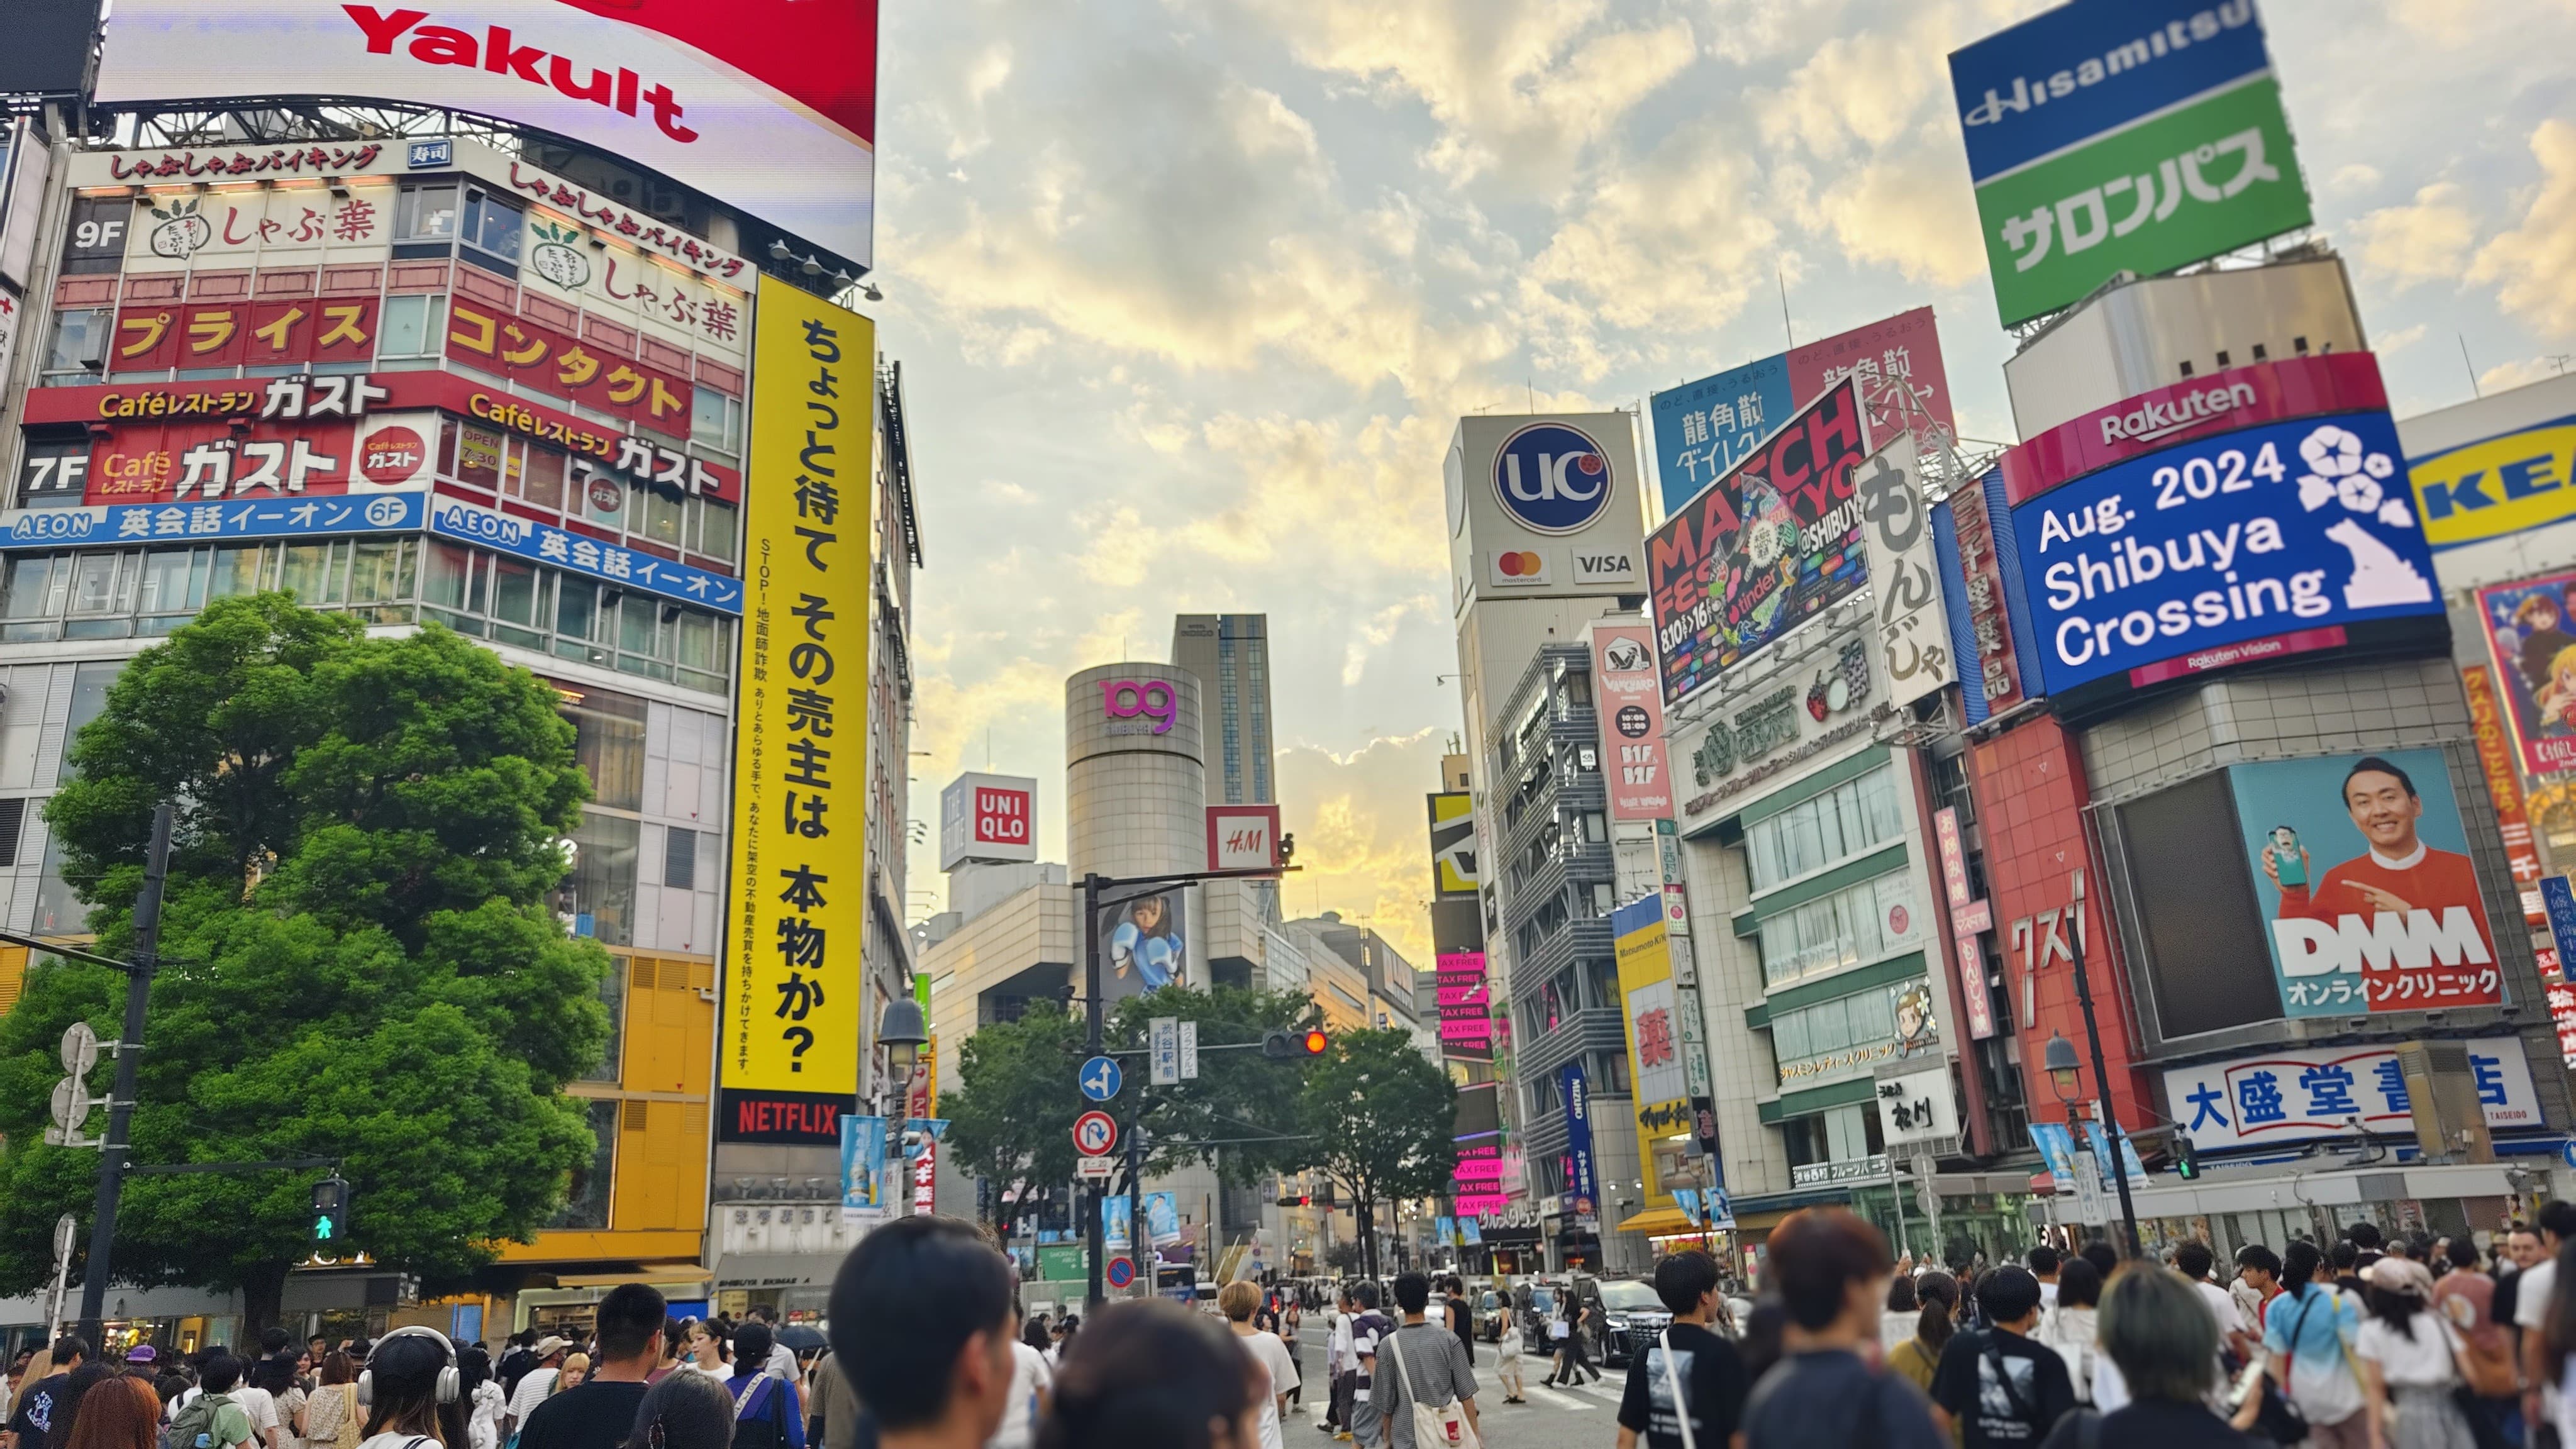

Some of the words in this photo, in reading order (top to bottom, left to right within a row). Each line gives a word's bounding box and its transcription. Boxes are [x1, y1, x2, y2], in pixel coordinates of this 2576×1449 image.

[341, 4, 698, 143] Yakult
[1965, 0, 2253, 125] Hisamitsu
[110, 144, 382, 180] しゃぶしゃぶバイキング
[411, 143, 449, 163] 寿司
[222, 199, 376, 245] しゃぶ葉
[510, 161, 745, 278] しゃぶしゃぶバイキング
[2001, 126, 2280, 273] サロンパス
[74, 220, 124, 249] 9F
[605, 257, 738, 342] しゃぶ葉
[122, 305, 369, 357] プライス
[450, 306, 684, 418] コンタクト
[262, 375, 388, 419] ガスト
[1682, 391, 1765, 447] 龍角散
[2101, 382, 2257, 445] Rakuten
[367, 452, 418, 469] ガスト
[463, 430, 499, 448] OPEN
[793, 318, 841, 573] ちょっと待て
[1675, 428, 1766, 482] ダイレク
[28, 455, 88, 491] 7F
[101, 479, 167, 495] レストラン
[103, 450, 172, 479] Café
[176, 439, 336, 499] ガスト
[616, 436, 719, 494] ガスト
[2421, 446, 2576, 521] KE
[16, 513, 92, 536] AEON
[118, 503, 352, 538] 英会話イーオン
[369, 501, 404, 522] 6F
[2039, 494, 2135, 553] Aug.
[2151, 442, 2287, 511] 2024
[447, 508, 519, 543] AEON
[539, 530, 738, 603] 英会話イーオン
[1576, 556, 1631, 572] VISA
[1860, 456, 1946, 682] もんじゃ
[2044, 516, 2285, 612] Shibuya
[1738, 568, 1777, 614] tinder
[1950, 489, 2011, 701] 三千里薬品
[1661, 619, 1682, 654] 8.10
[1692, 602, 1707, 630] 16
[2055, 569, 2332, 667] Crossing
[2187, 648, 2240, 669] Rakuten
[2240, 638, 2281, 660] Vision
[784, 592, 835, 840] その売主は
[1099, 681, 1177, 735] 109
[1620, 745, 1653, 763] B1F
[1622, 765, 1657, 786] B2F
[981, 794, 1020, 816] UNI
[980, 816, 1024, 840] QLO
[1226, 829, 1262, 853] H&M
[1619, 940, 1653, 958] Matsumoto
[2272, 906, 2492, 979] DMM
[775, 864, 829, 1072] 本物か？
[1457, 974, 1480, 982] FREE
[2287, 969, 2497, 1006] オンラインクリニック
[1460, 1008, 1483, 1016] FREE
[1461, 1024, 1485, 1032] FREE
[1161, 1023, 1175, 1079] 渋谷駅前
[1182, 1024, 1195, 1077] スクランブル式
[1636, 1008, 1674, 1067] 薬
[1780, 1042, 1896, 1079] ジャスミンレディースクリニック
[738, 1099, 838, 1135] NETFLIX
[1572, 1078, 1583, 1120] MIZUHO
[2490, 1110, 2528, 1121] TAISEIDO
[1474, 1164, 1497, 1173] FREE
[1475, 1182, 1499, 1191] FREE
[1577, 1150, 1590, 1195] みずほ銀行
[1831, 1159, 1889, 1179] フルーツパーラ
